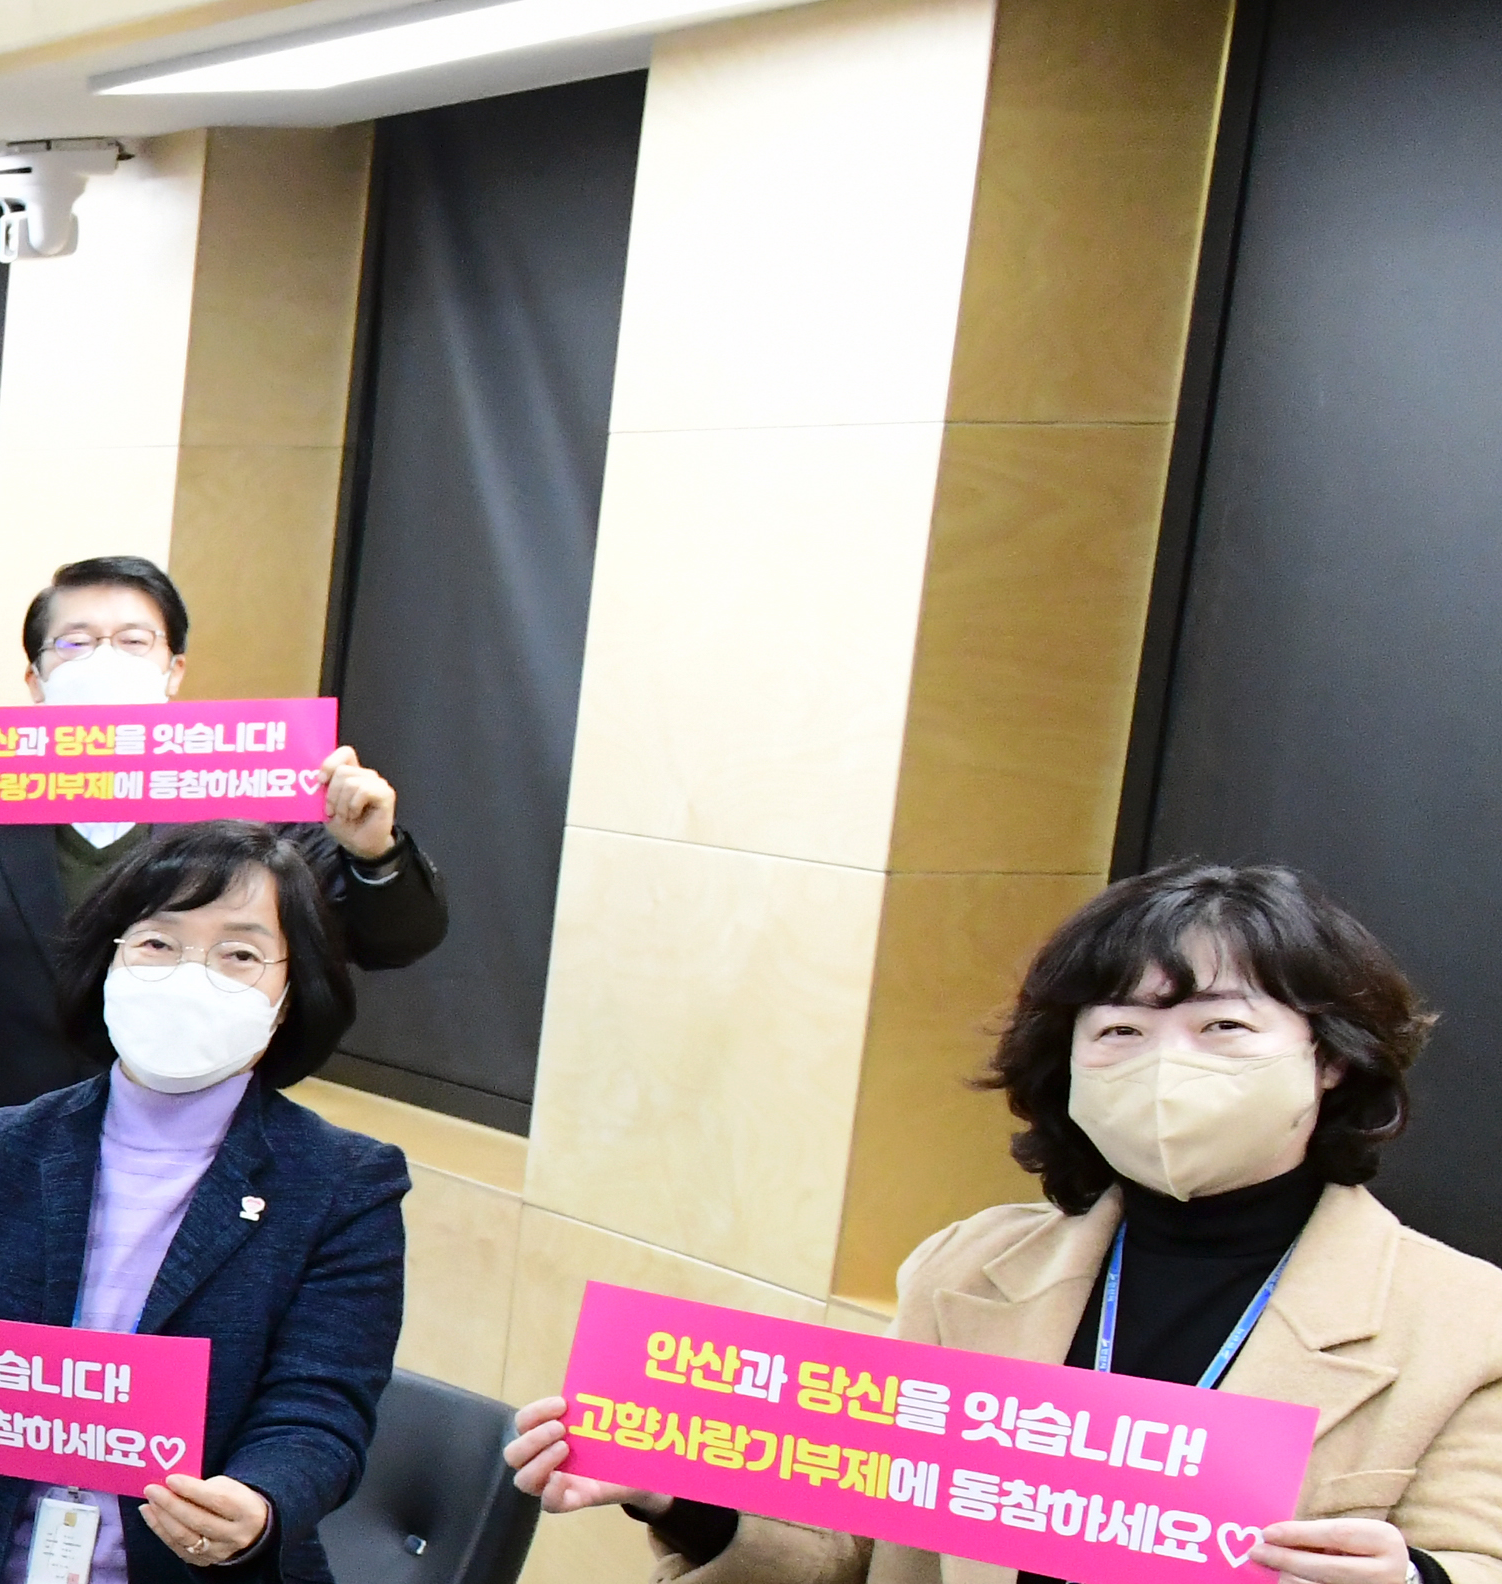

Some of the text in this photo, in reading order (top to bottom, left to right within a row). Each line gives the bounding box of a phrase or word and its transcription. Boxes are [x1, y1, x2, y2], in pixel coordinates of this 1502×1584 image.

[55, 725, 146, 756] 당신을
[153, 721, 286, 754] 잇습니다!
[149, 769, 296, 799] 동참하세요
[646, 1332, 1207, 1477] 안산과 당신을 잇습니다!
[569, 1393, 1211, 1563] 고향사랑기부제에 동참하세요
